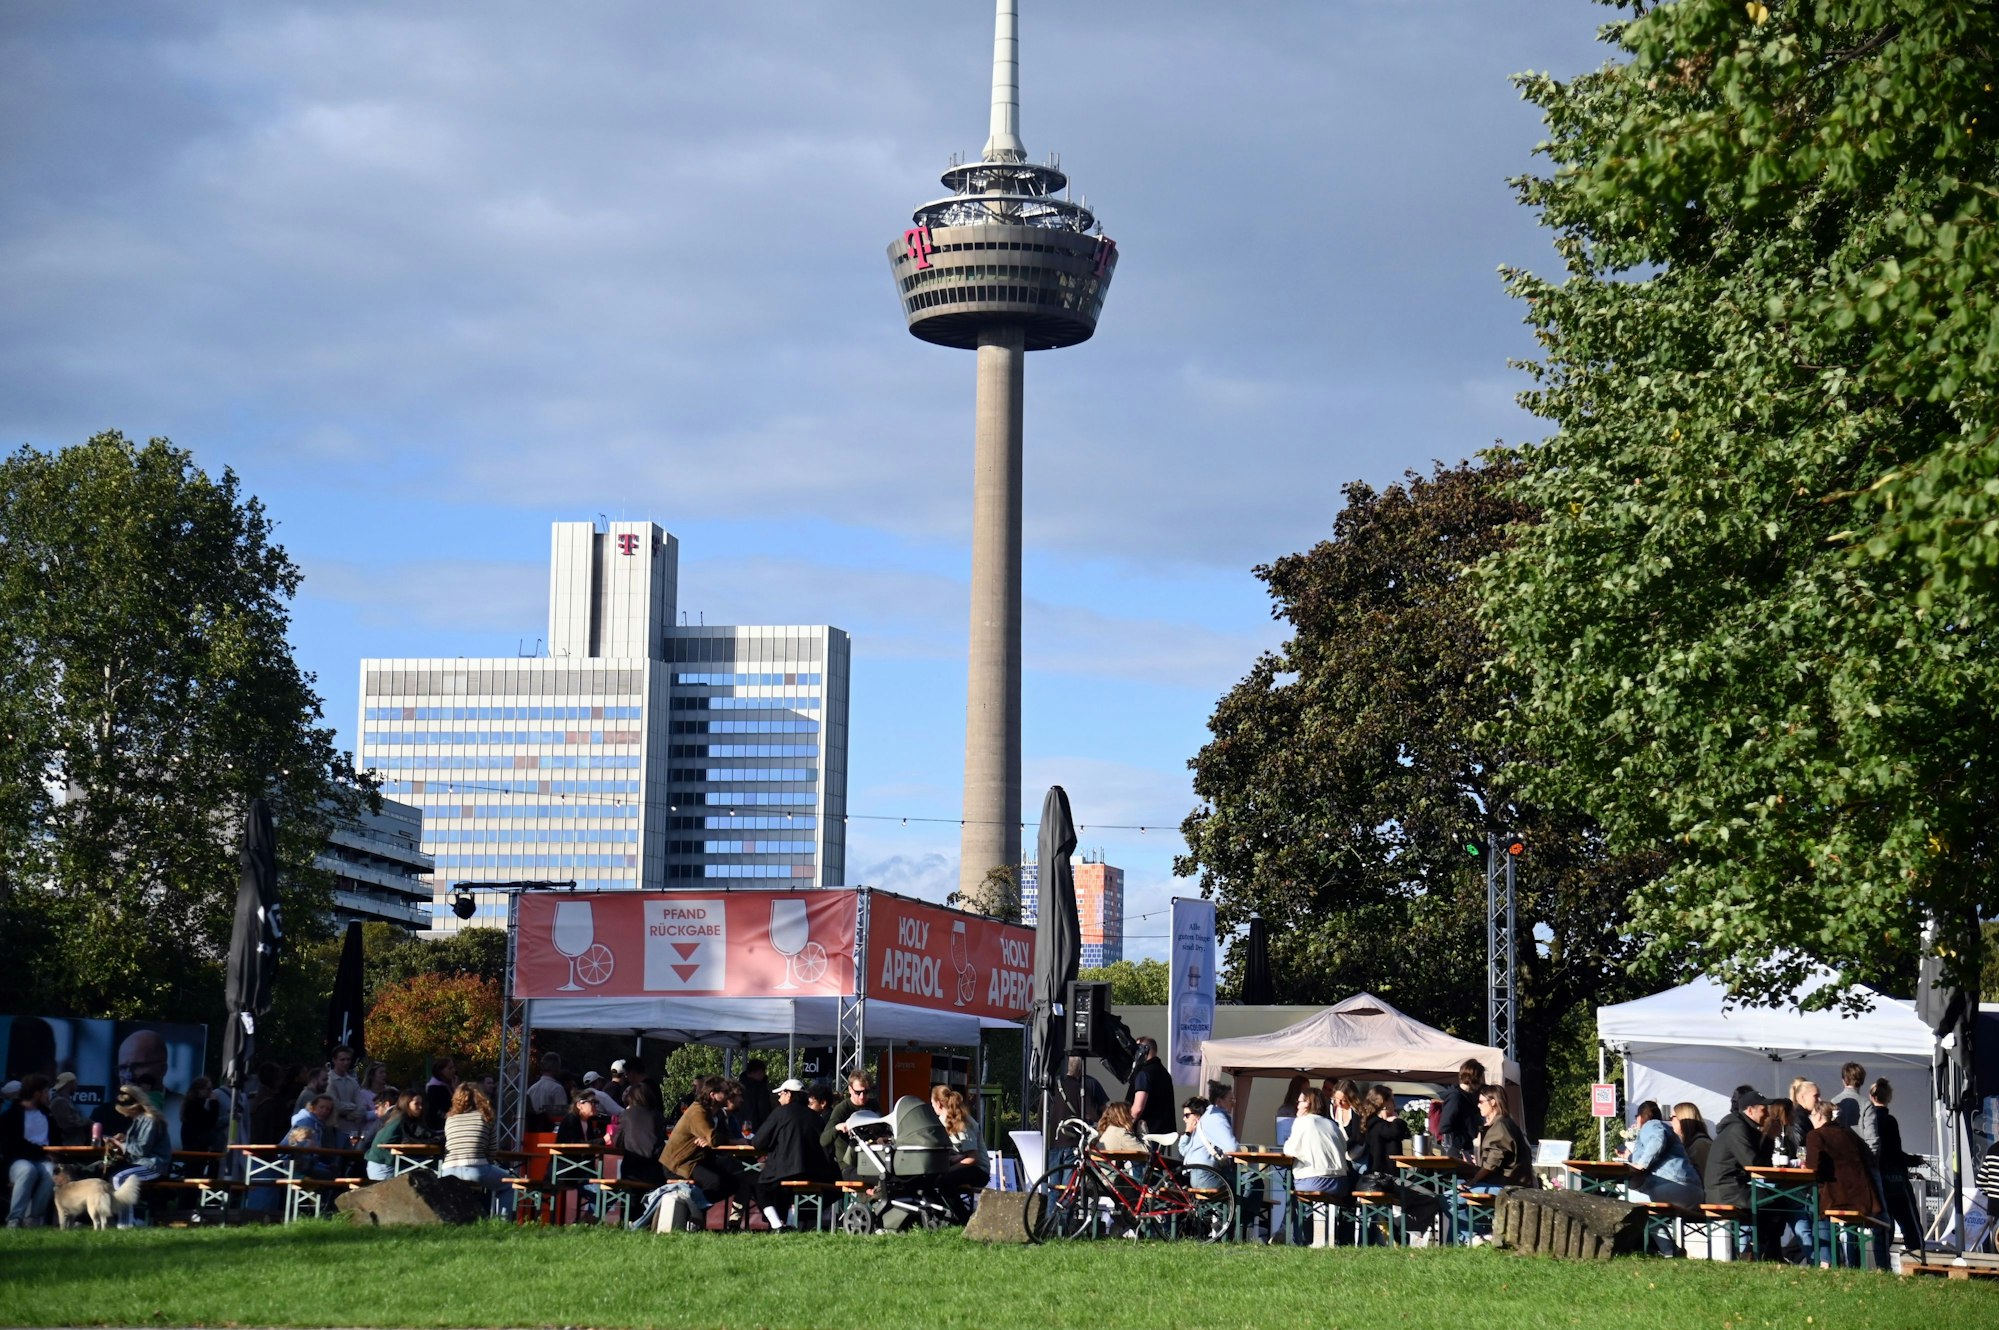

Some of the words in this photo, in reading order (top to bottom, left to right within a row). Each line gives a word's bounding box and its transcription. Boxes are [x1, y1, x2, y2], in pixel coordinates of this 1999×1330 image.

[904, 226, 932, 270] T
[618, 534, 639, 556] T
[650, 923, 721, 936] RÜCKGABE
[663, 909, 706, 919] PFAND
[1189, 923, 1201, 931] Alle
[898, 916, 930, 950] HOLY
[1000, 937, 1030, 969] HOLY
[881, 948, 943, 998] APEROL
[987, 967, 1035, 1013] APERO
